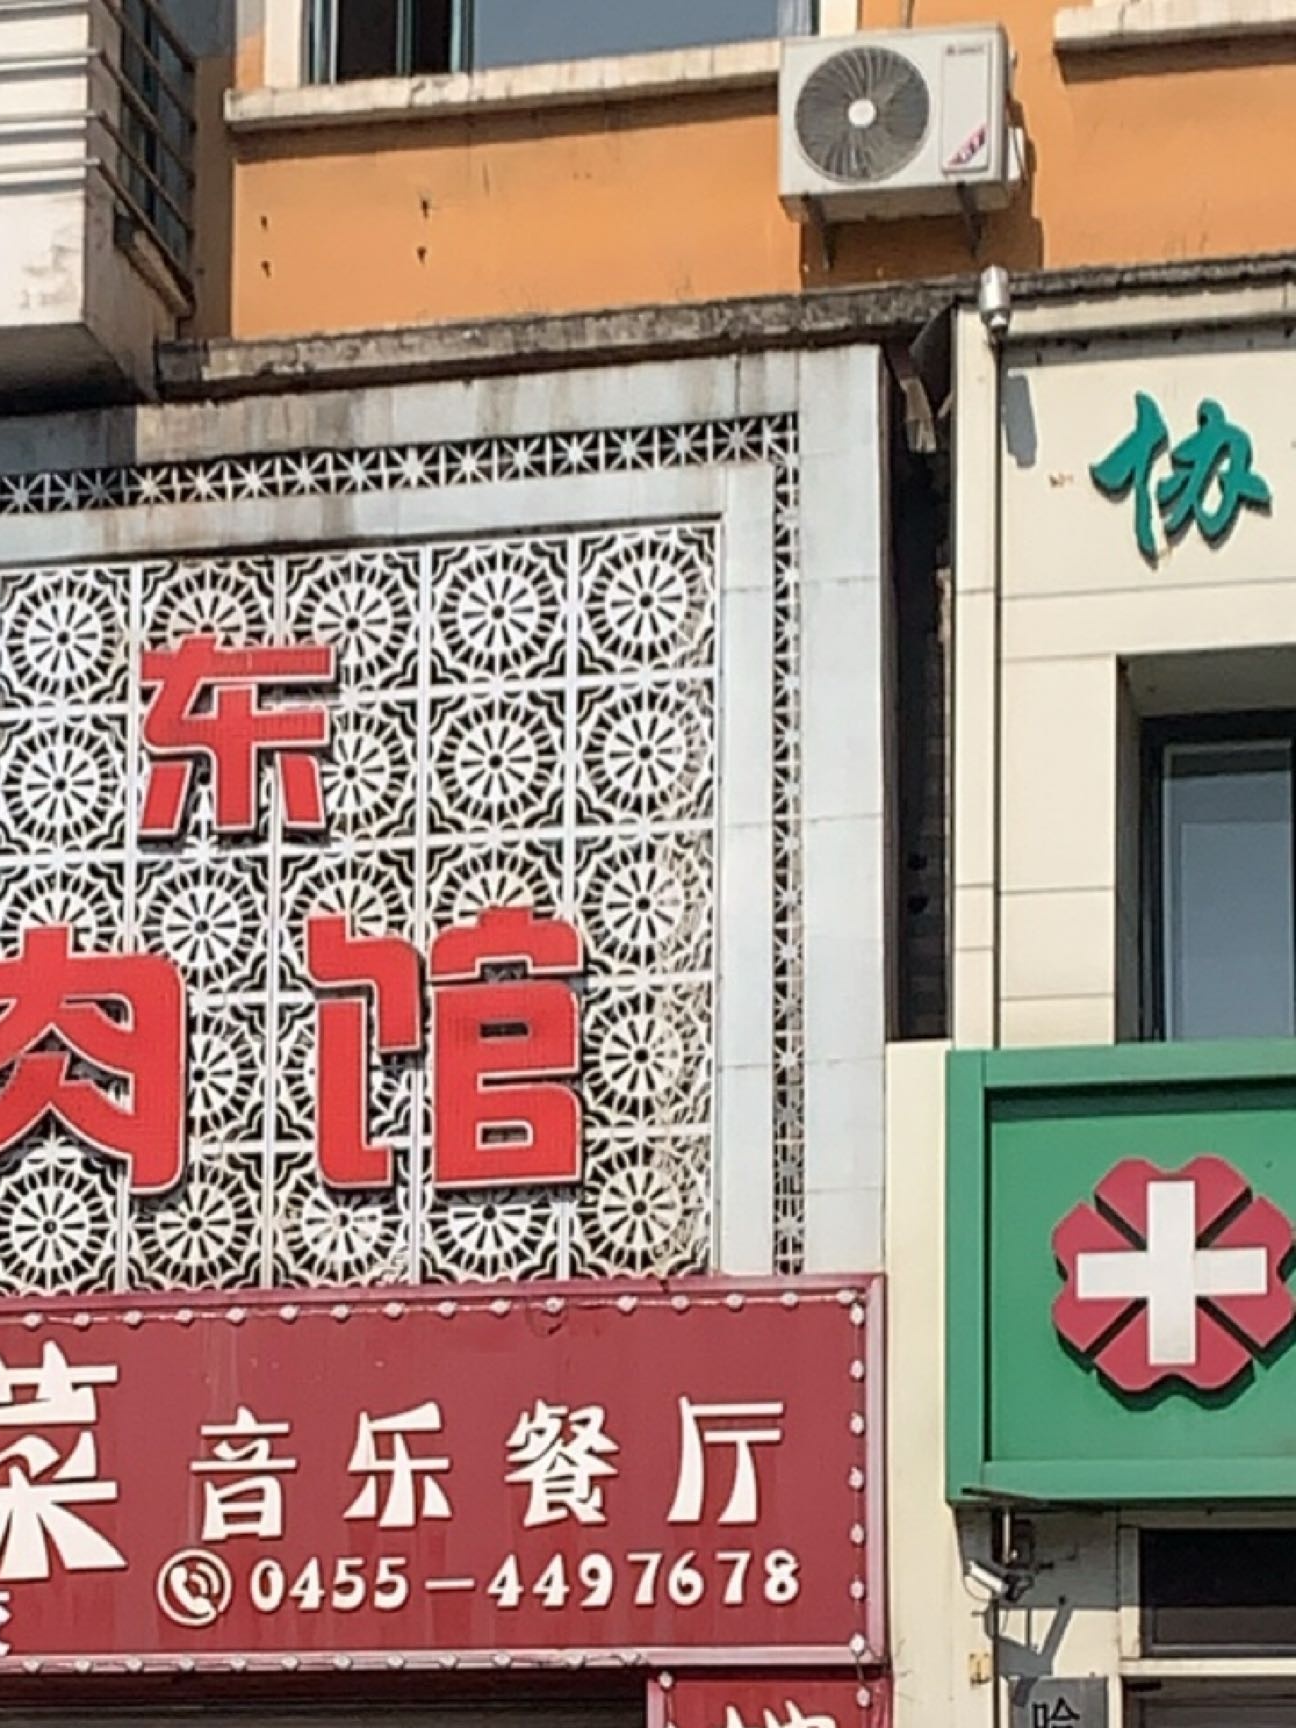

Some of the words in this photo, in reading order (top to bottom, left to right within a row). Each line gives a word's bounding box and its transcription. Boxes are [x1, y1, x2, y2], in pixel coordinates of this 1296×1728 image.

[1089, 391, 1273, 566] 协
[190, 1397, 784, 1542] 音乐餐厅
